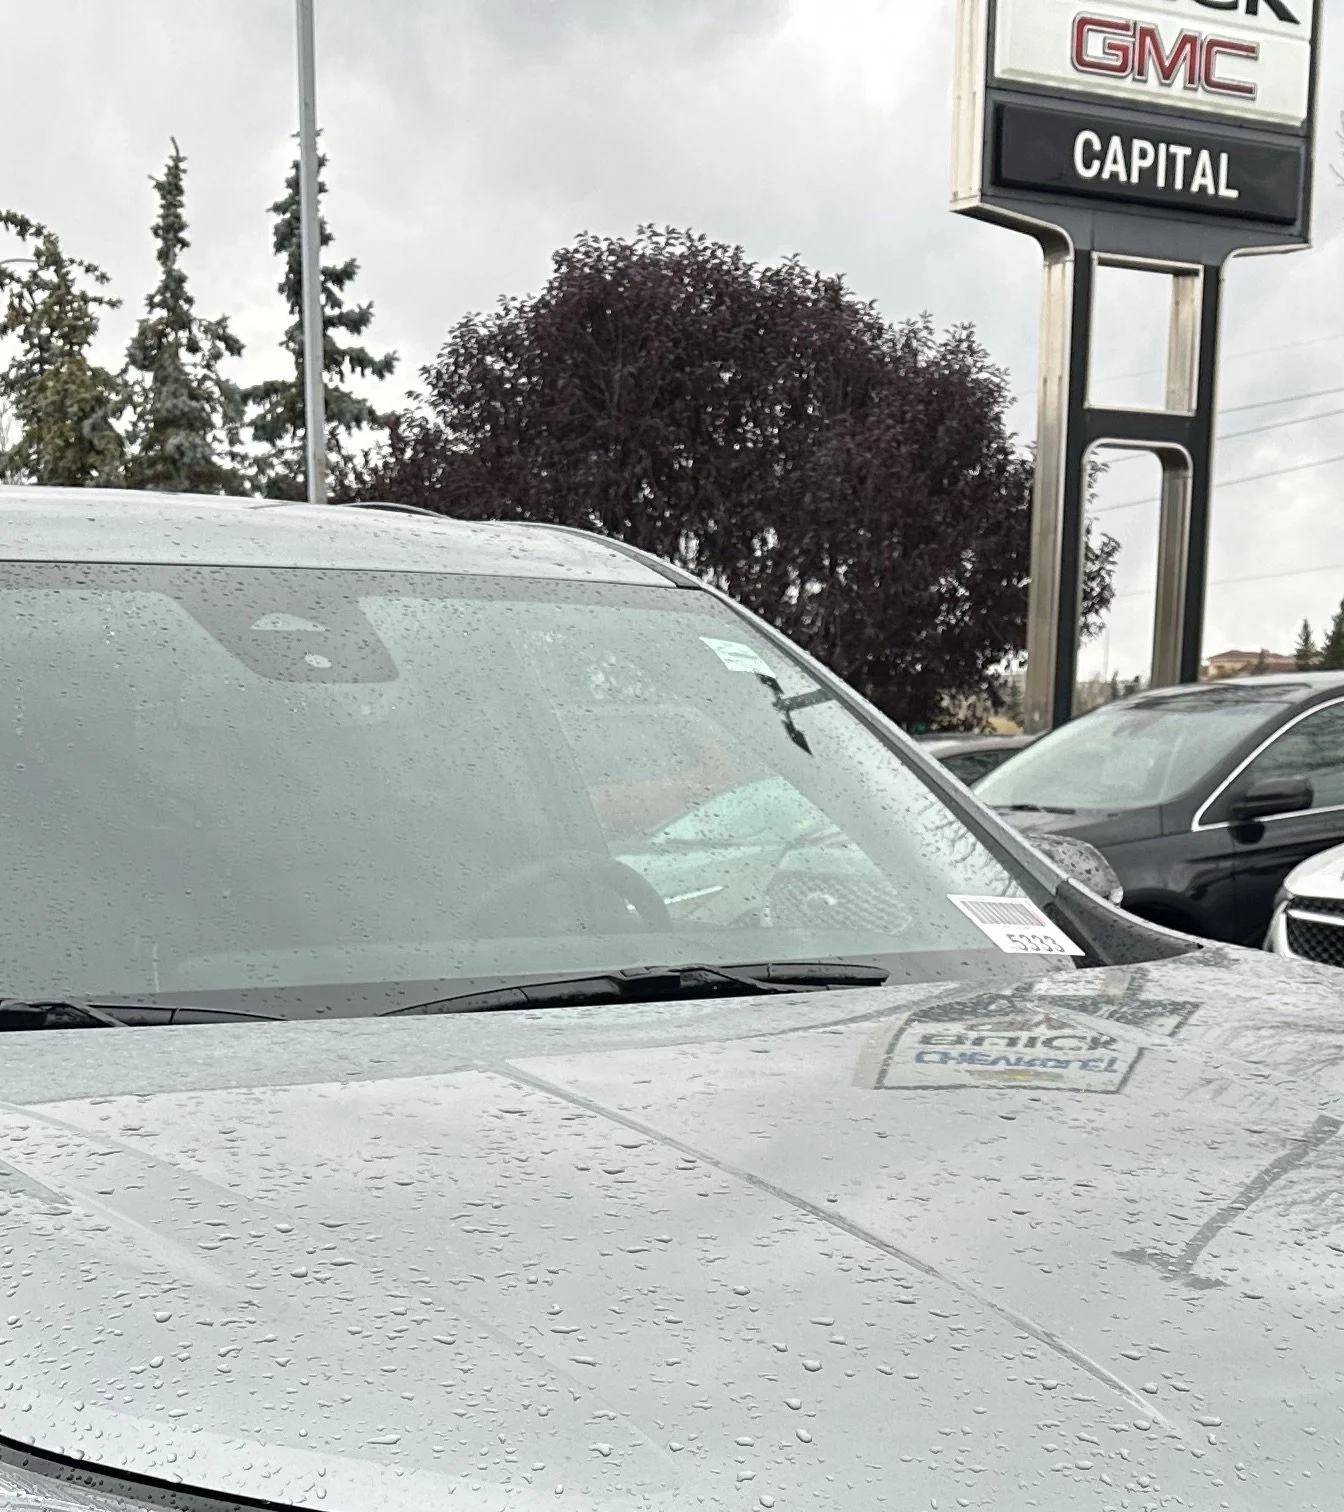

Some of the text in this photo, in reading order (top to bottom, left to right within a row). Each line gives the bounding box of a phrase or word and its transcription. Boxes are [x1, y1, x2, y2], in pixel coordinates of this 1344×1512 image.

[1071, 11, 1259, 100] GMC
[1074, 130, 1239, 199] CAPITAL
[1006, 934, 1065, 953] 5333
